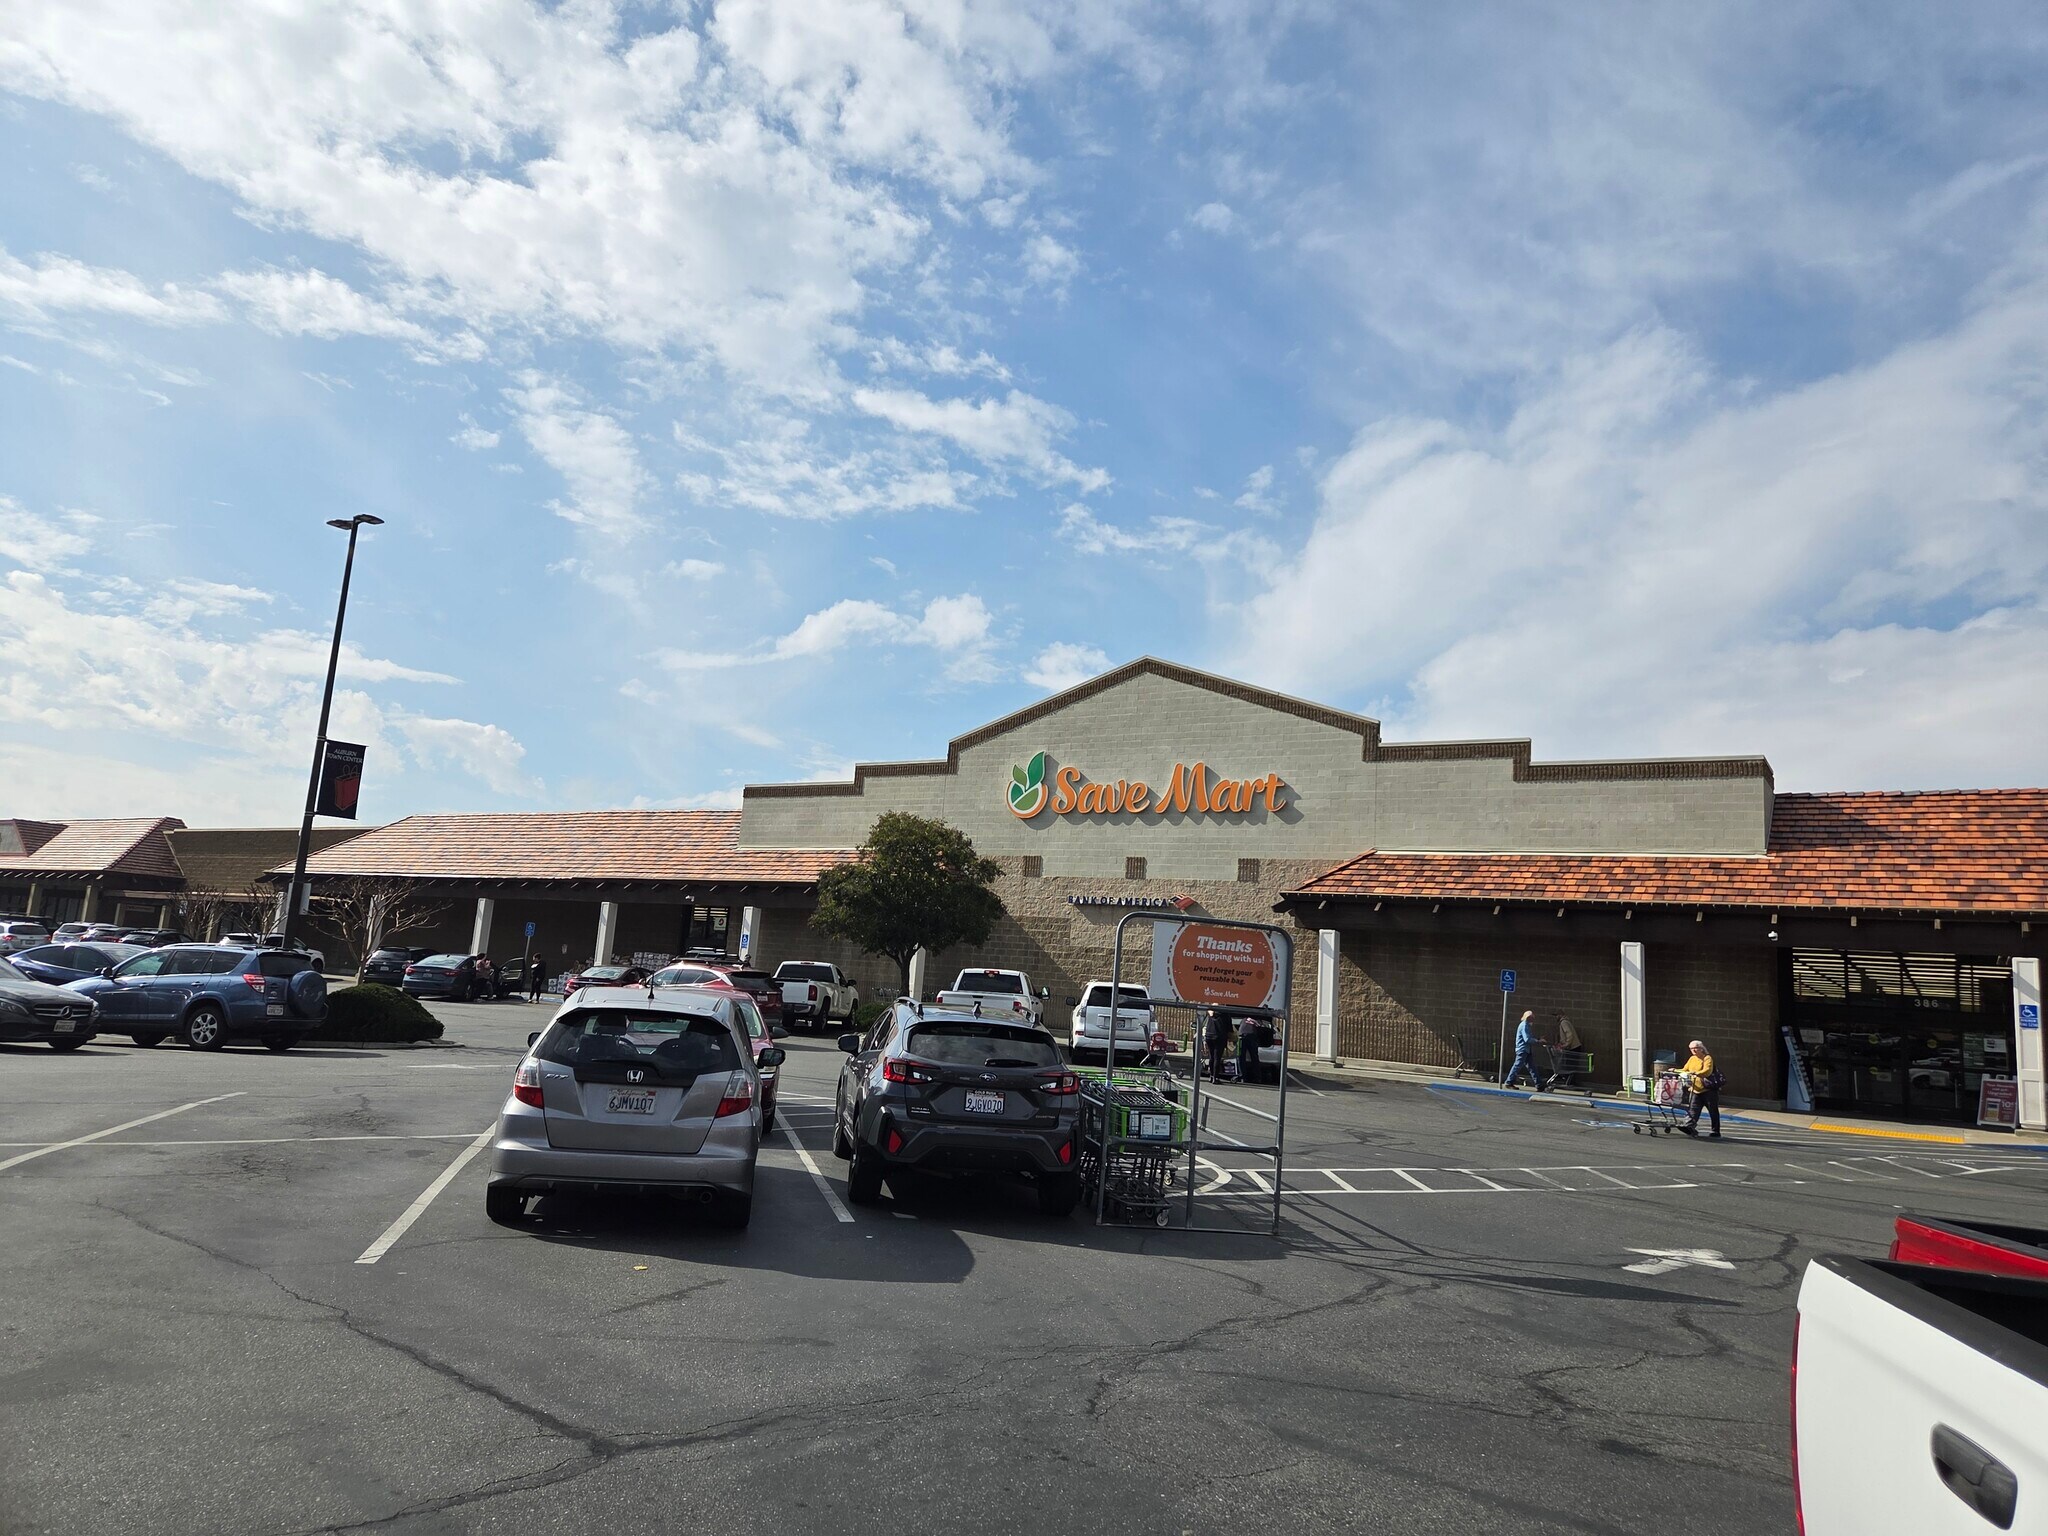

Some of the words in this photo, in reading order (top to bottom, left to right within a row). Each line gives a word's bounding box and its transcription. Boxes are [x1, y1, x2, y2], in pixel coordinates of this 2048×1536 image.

[327, 752, 342, 760] TOWN
[1050, 765, 1150, 814] Save
[1154, 761, 1287, 814] Mart
[1067, 895, 1097, 905] BANK
[1100, 896, 1113, 906] OF
[1116, 897, 1168, 907] AMERICA
[1197, 935, 1253, 953] Thanks
[1182, 949, 1195, 957] for
[1196, 950, 1232, 963] shopping
[1233, 954, 1252, 963] with
[1253, 955, 1265, 964] us!
[1193, 965, 1212, 973] Don't
[1212, 966, 1235, 976] forget
[1199, 975, 1231, 983] reusable
[1231, 977, 1246, 986] bag.
[1210, 989, 1223, 997] Save
[1223, 990, 1239, 998] Mart
[1914, 999, 1938, 1007] 386
[608, 1096, 654, 1111] 6JMV107
